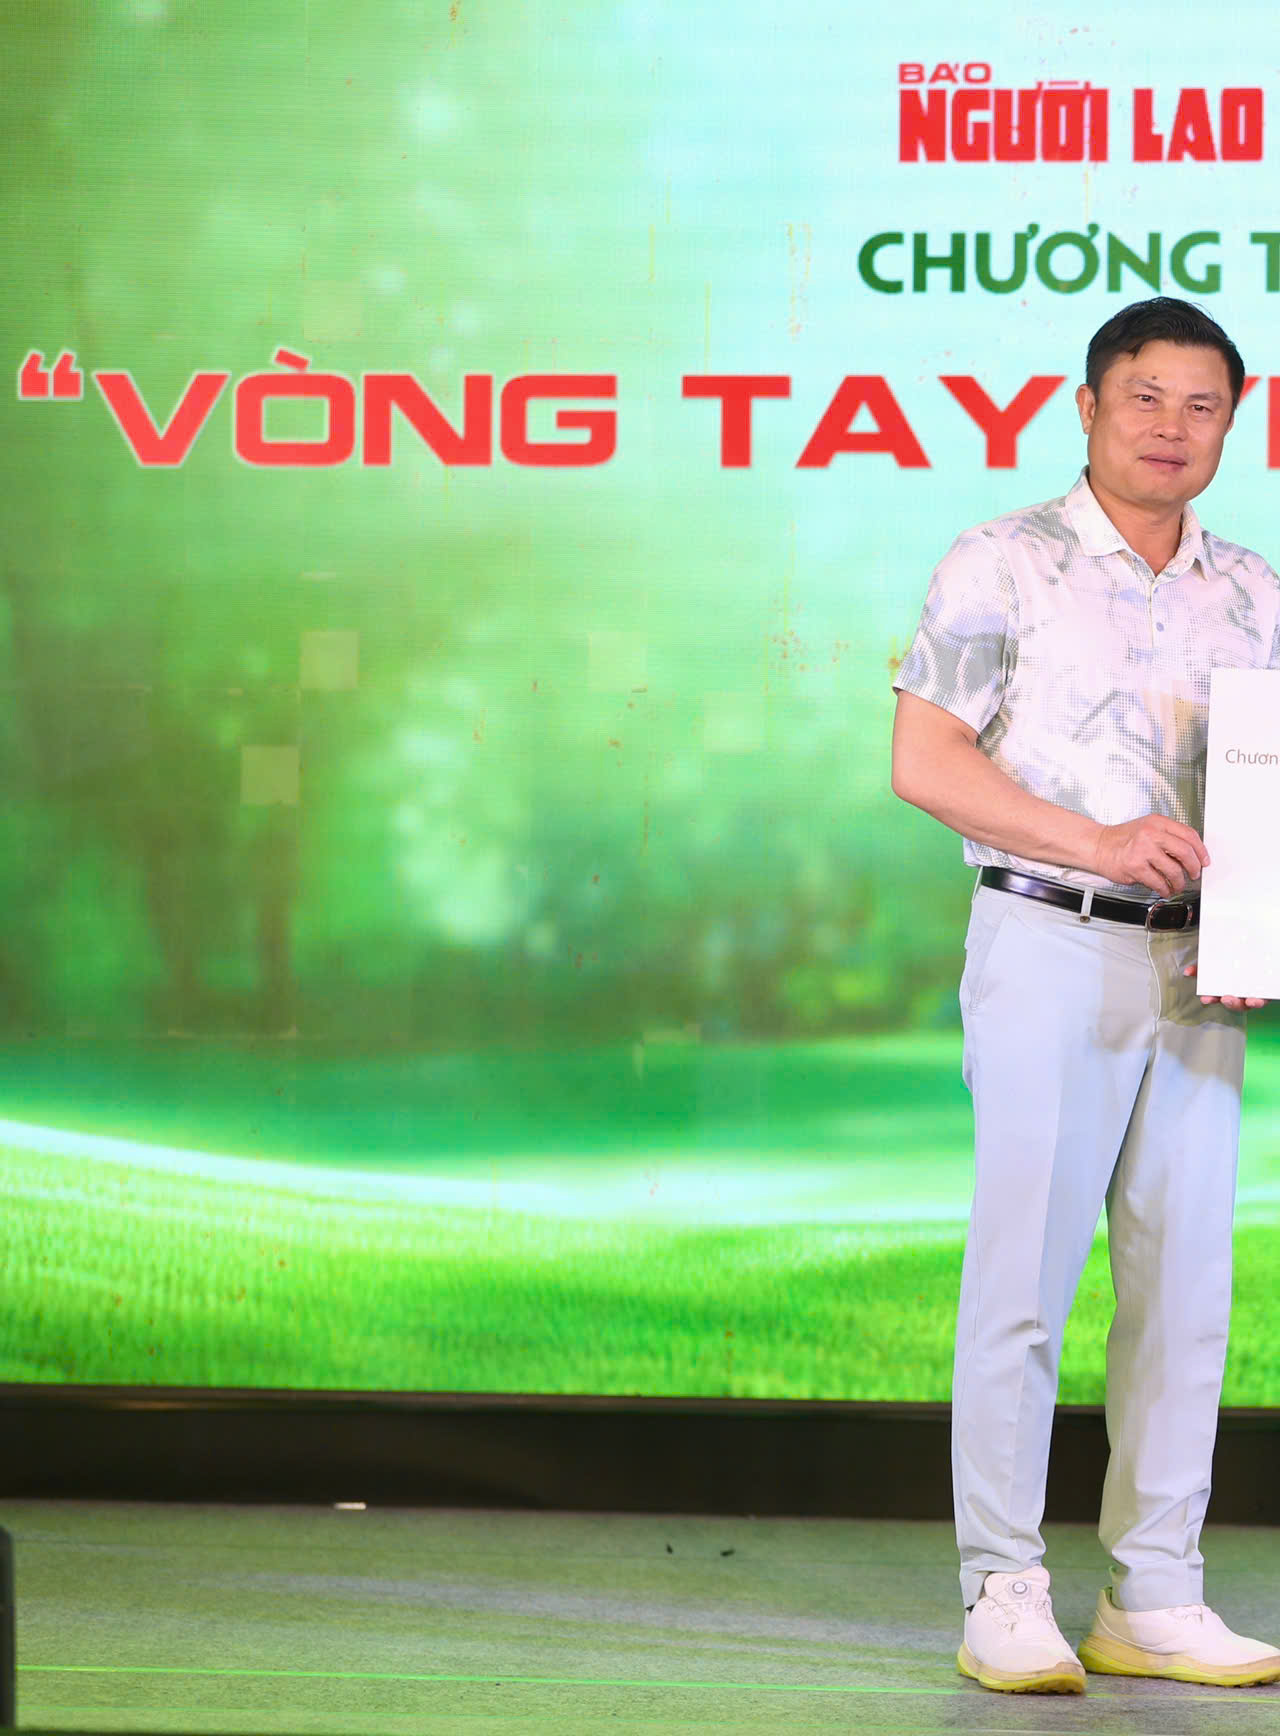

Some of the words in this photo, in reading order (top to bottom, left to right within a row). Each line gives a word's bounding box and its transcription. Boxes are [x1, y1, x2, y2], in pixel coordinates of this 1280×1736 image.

[899, 63, 991, 84] BÁO
[899, 81, 1108, 162] NGƯỜI
[1132, 88, 1263, 162] LAO
[858, 224, 1221, 294] CHƯƠNG
[682, 375, 1066, 468] TAY
